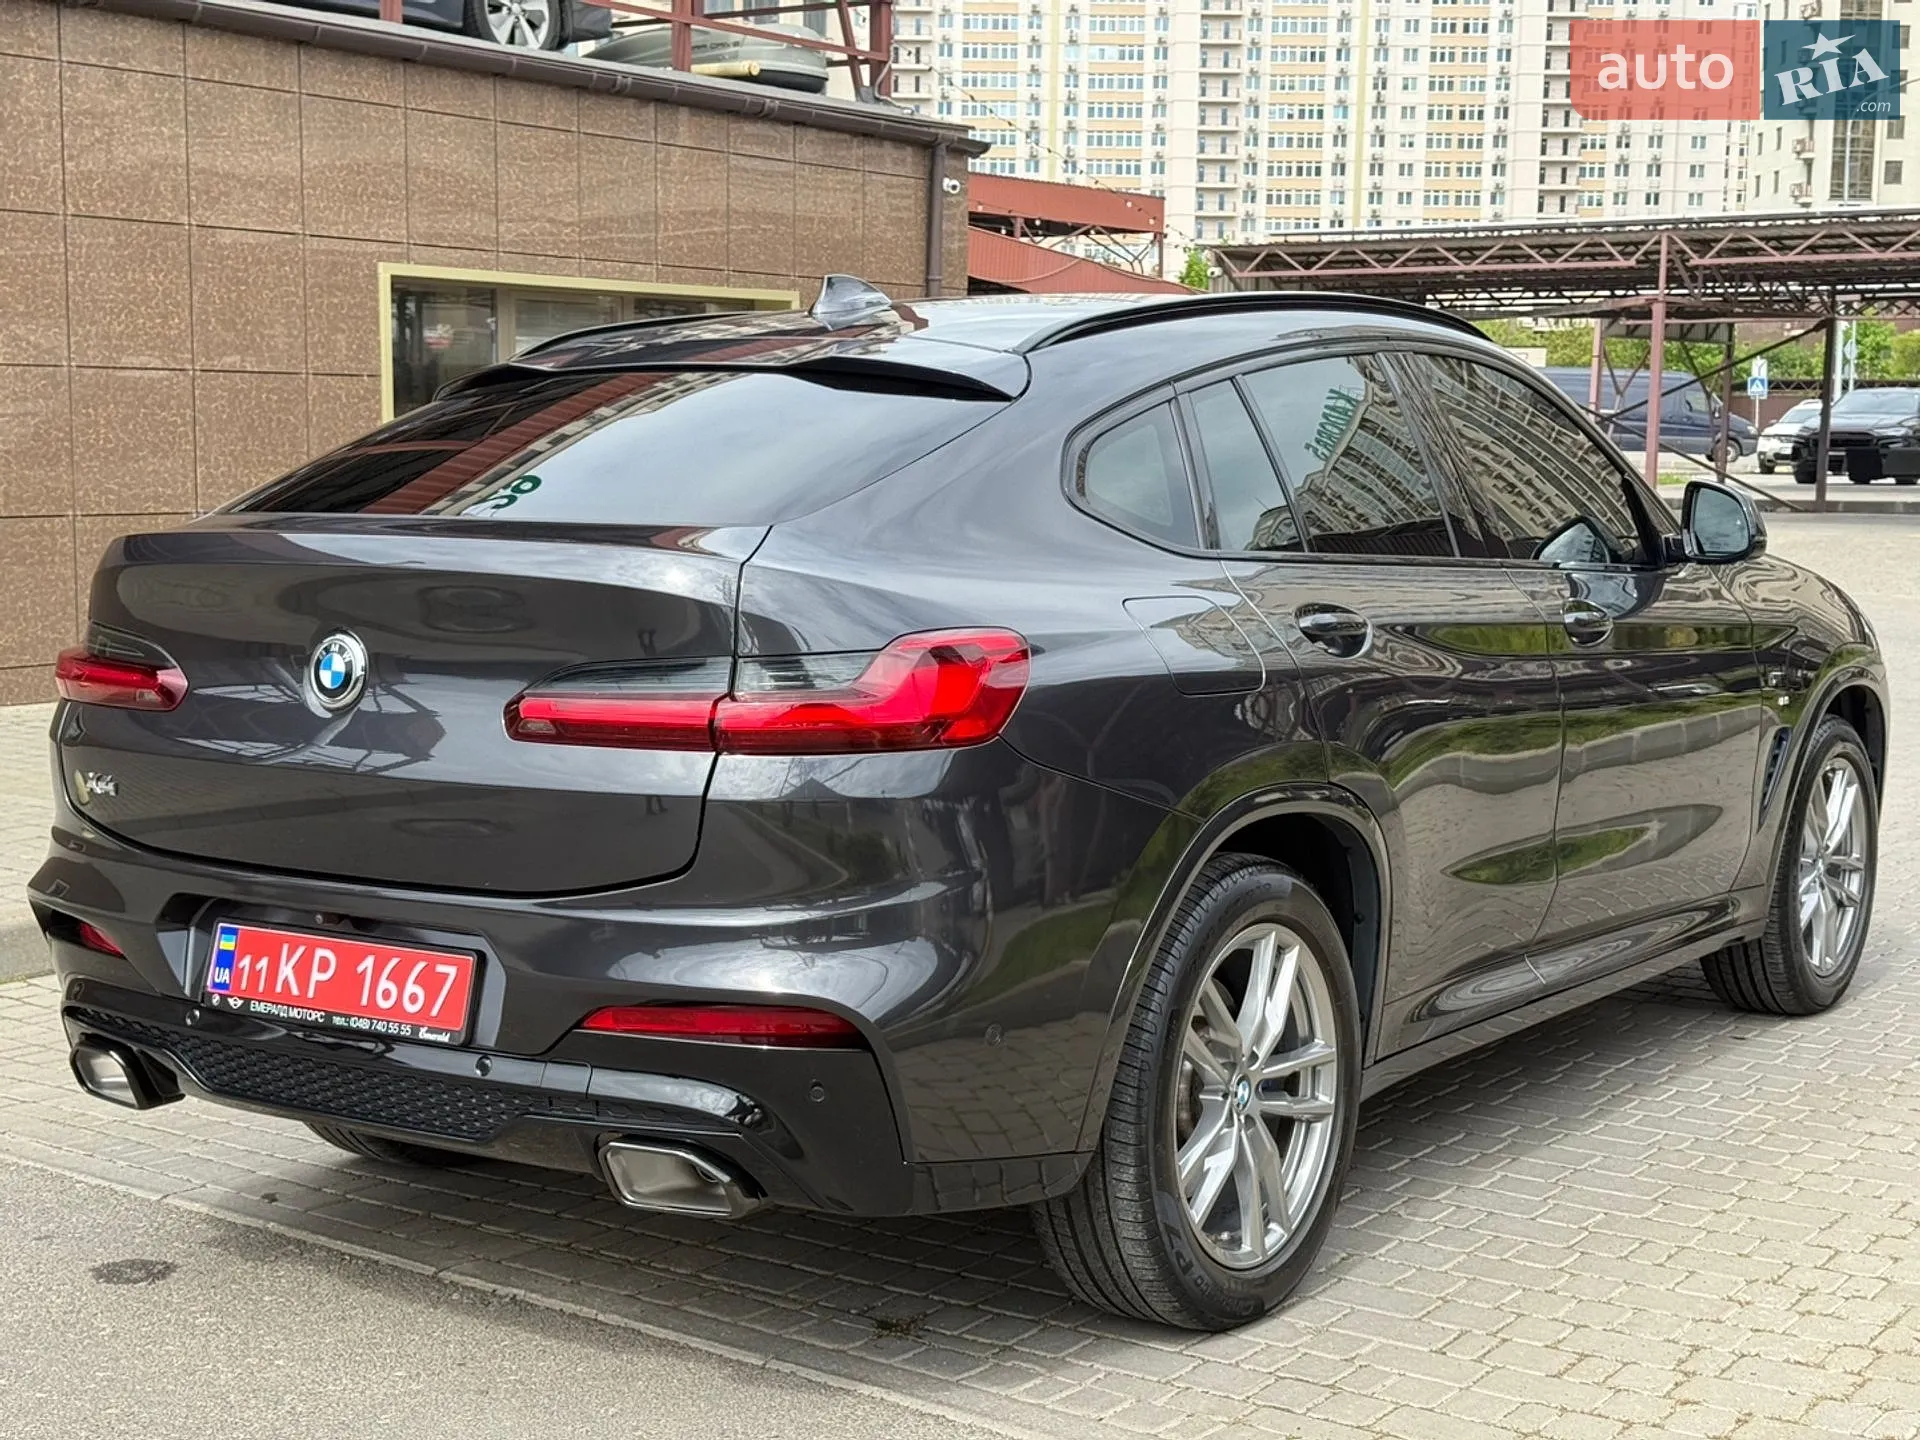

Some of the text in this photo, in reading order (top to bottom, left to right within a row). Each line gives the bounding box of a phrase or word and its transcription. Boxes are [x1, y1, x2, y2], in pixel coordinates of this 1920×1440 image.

[214, 967, 230, 984] UA
[356, 954, 458, 1017] 1667
[289, 1007, 325, 1022] МОТОРС
[371, 1019, 387, 1032] 740
[388, 1022, 399, 1034] 55
[400, 1024, 412, 1035] 55
